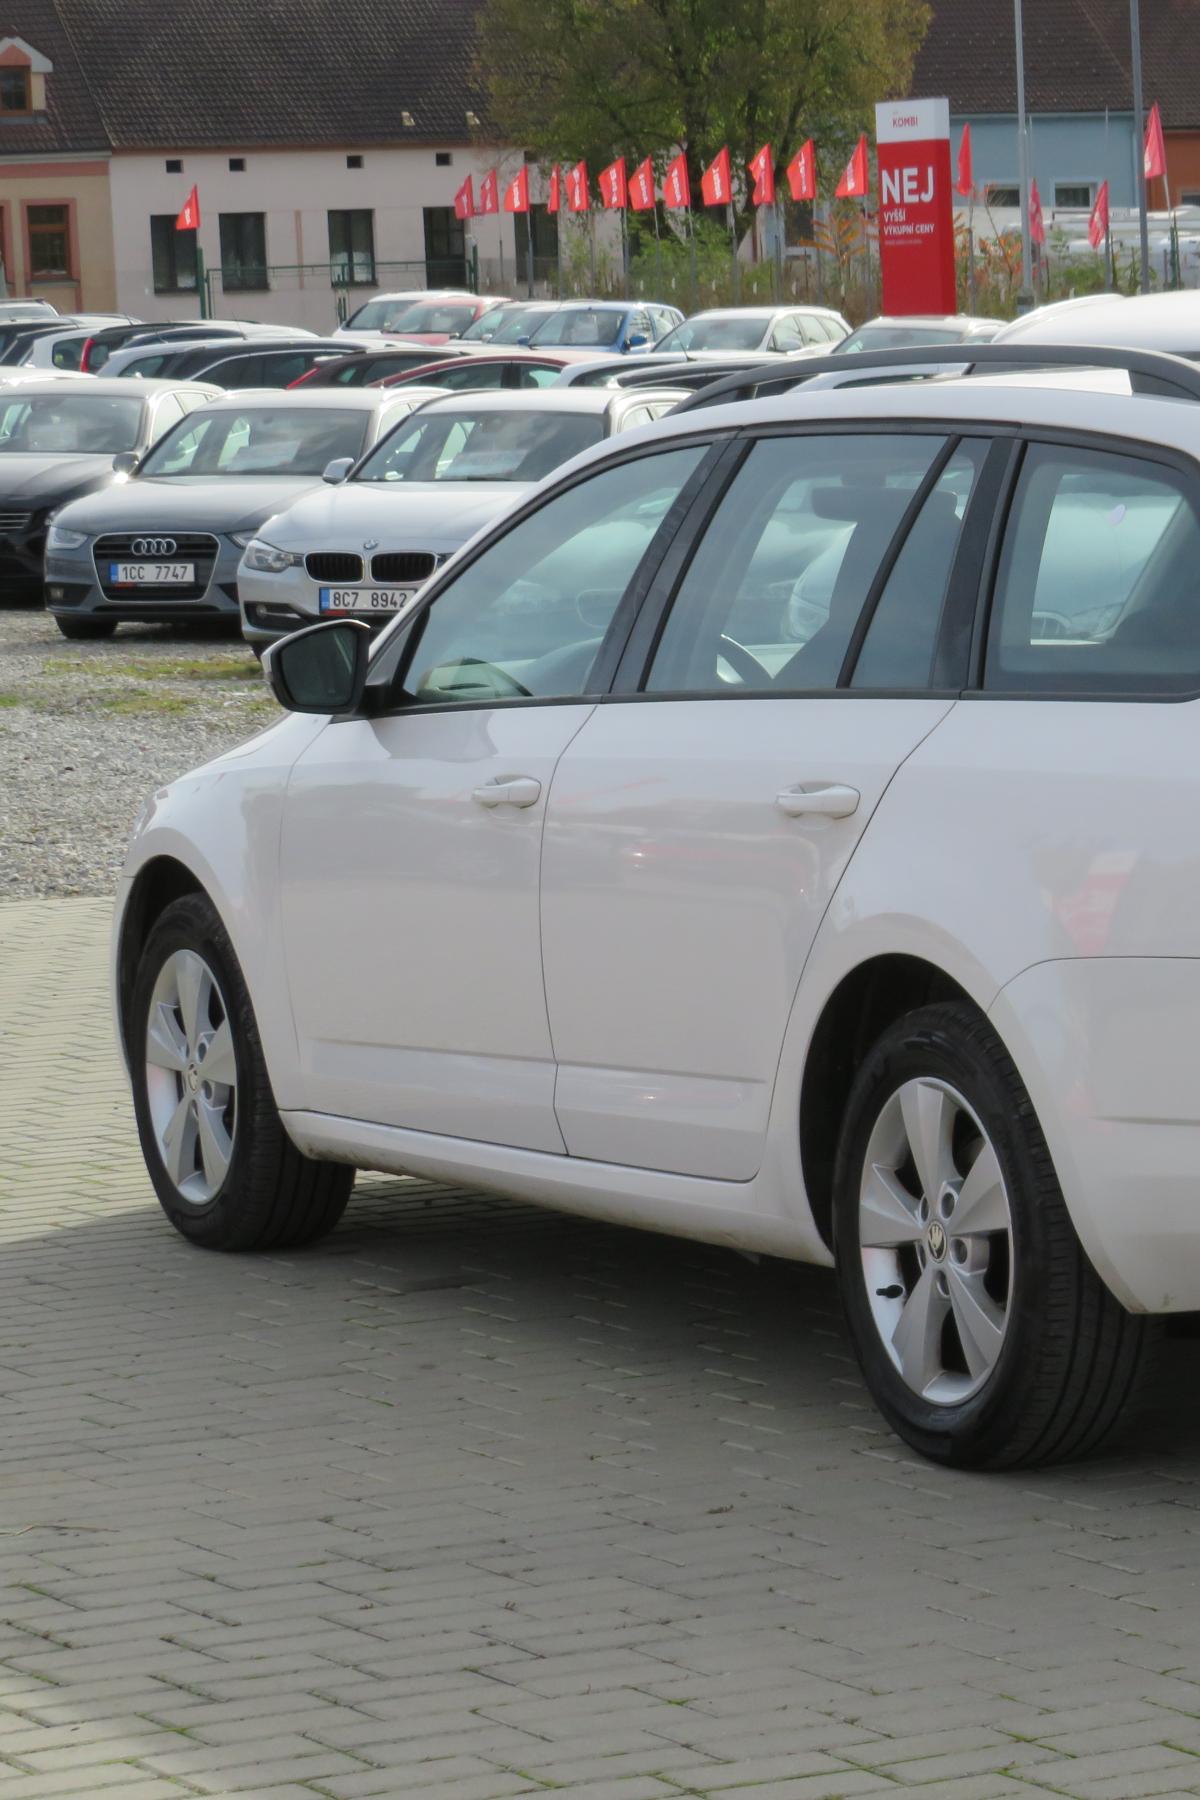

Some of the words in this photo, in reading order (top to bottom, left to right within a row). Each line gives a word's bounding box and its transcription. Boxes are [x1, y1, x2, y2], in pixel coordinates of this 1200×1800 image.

[881, 166, 934, 205] NEJ
[883, 208, 906, 223] VYŠŠÍ
[883, 223, 914, 236] VÝKUPNÍ
[915, 223, 935, 234] CENY
[122, 566, 145, 580] 1CC
[155, 565, 188, 580] 7747
[333, 592, 359, 607] 8C7
[371, 592, 407, 608] 8942
